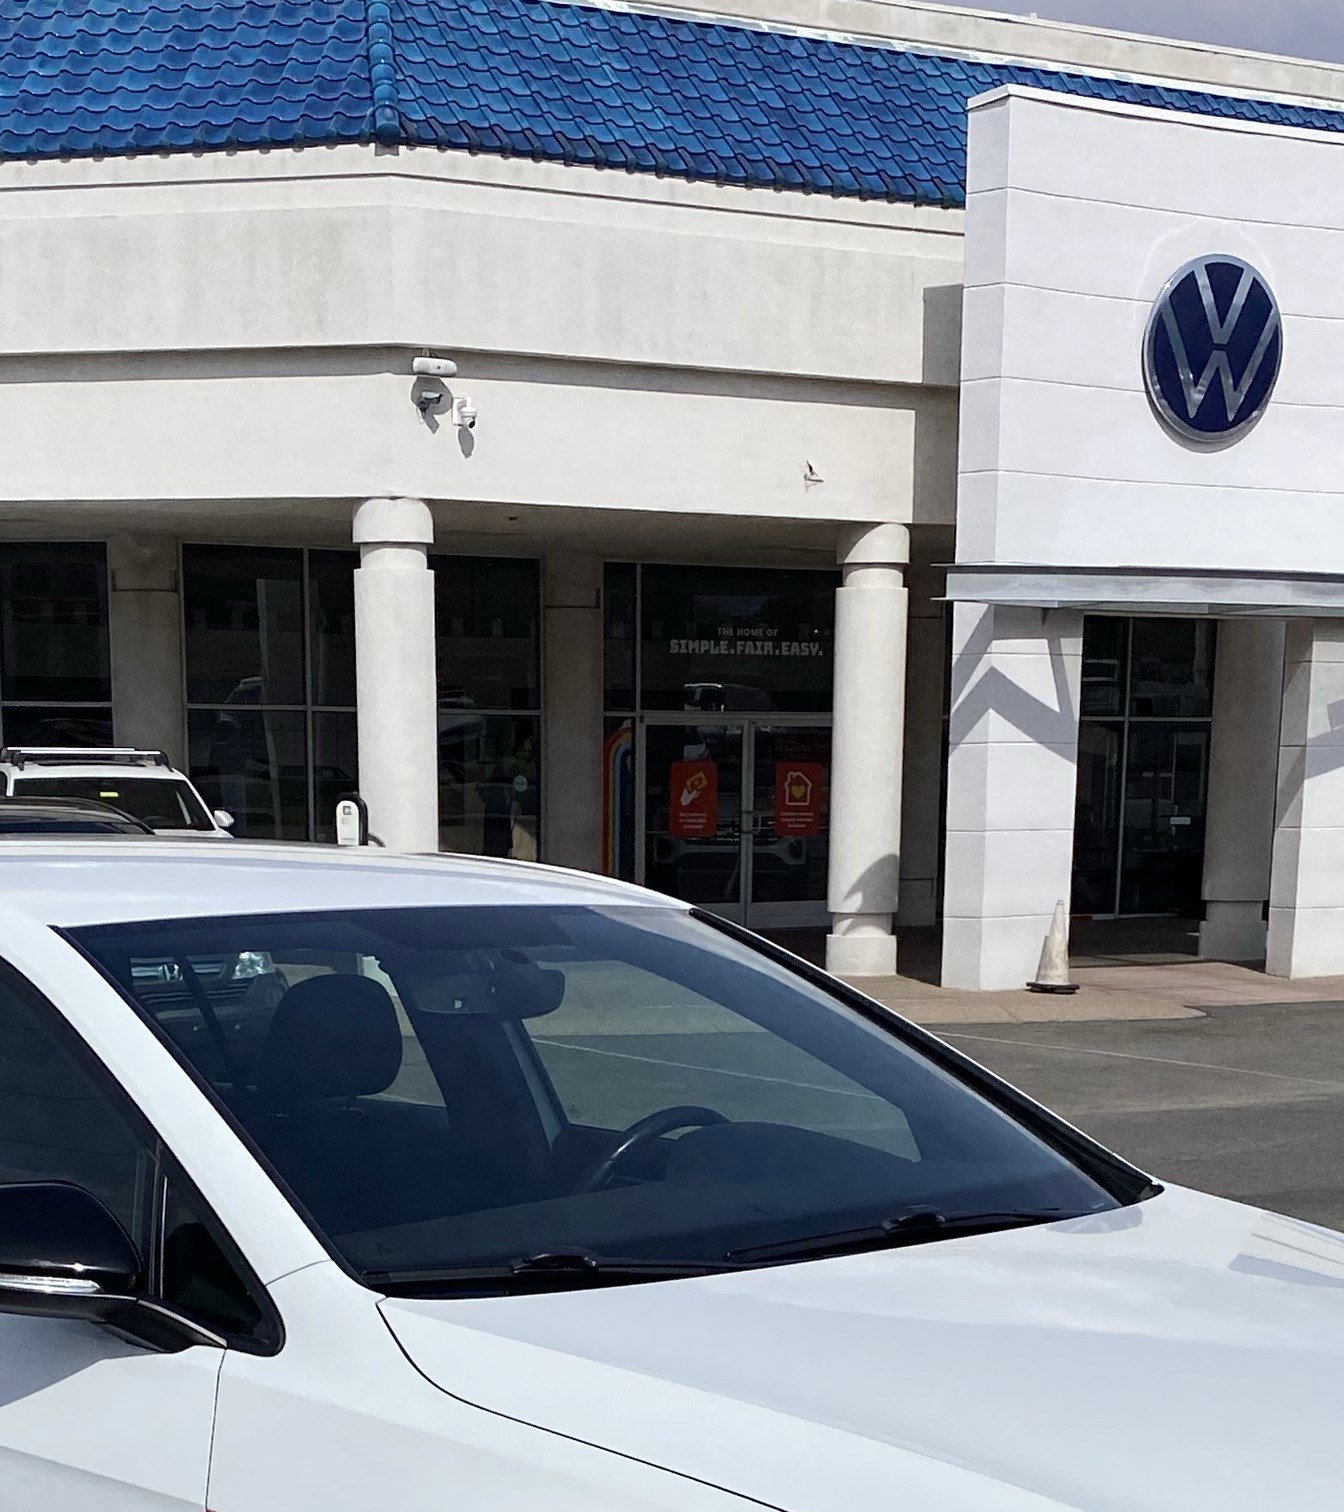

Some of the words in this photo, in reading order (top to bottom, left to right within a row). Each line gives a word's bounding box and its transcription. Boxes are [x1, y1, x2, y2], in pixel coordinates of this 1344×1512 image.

[1155, 257, 1281, 428] VW
[716, 626, 734, 637] THE
[737, 627, 764, 638] HOME
[765, 627, 779, 638] OF
